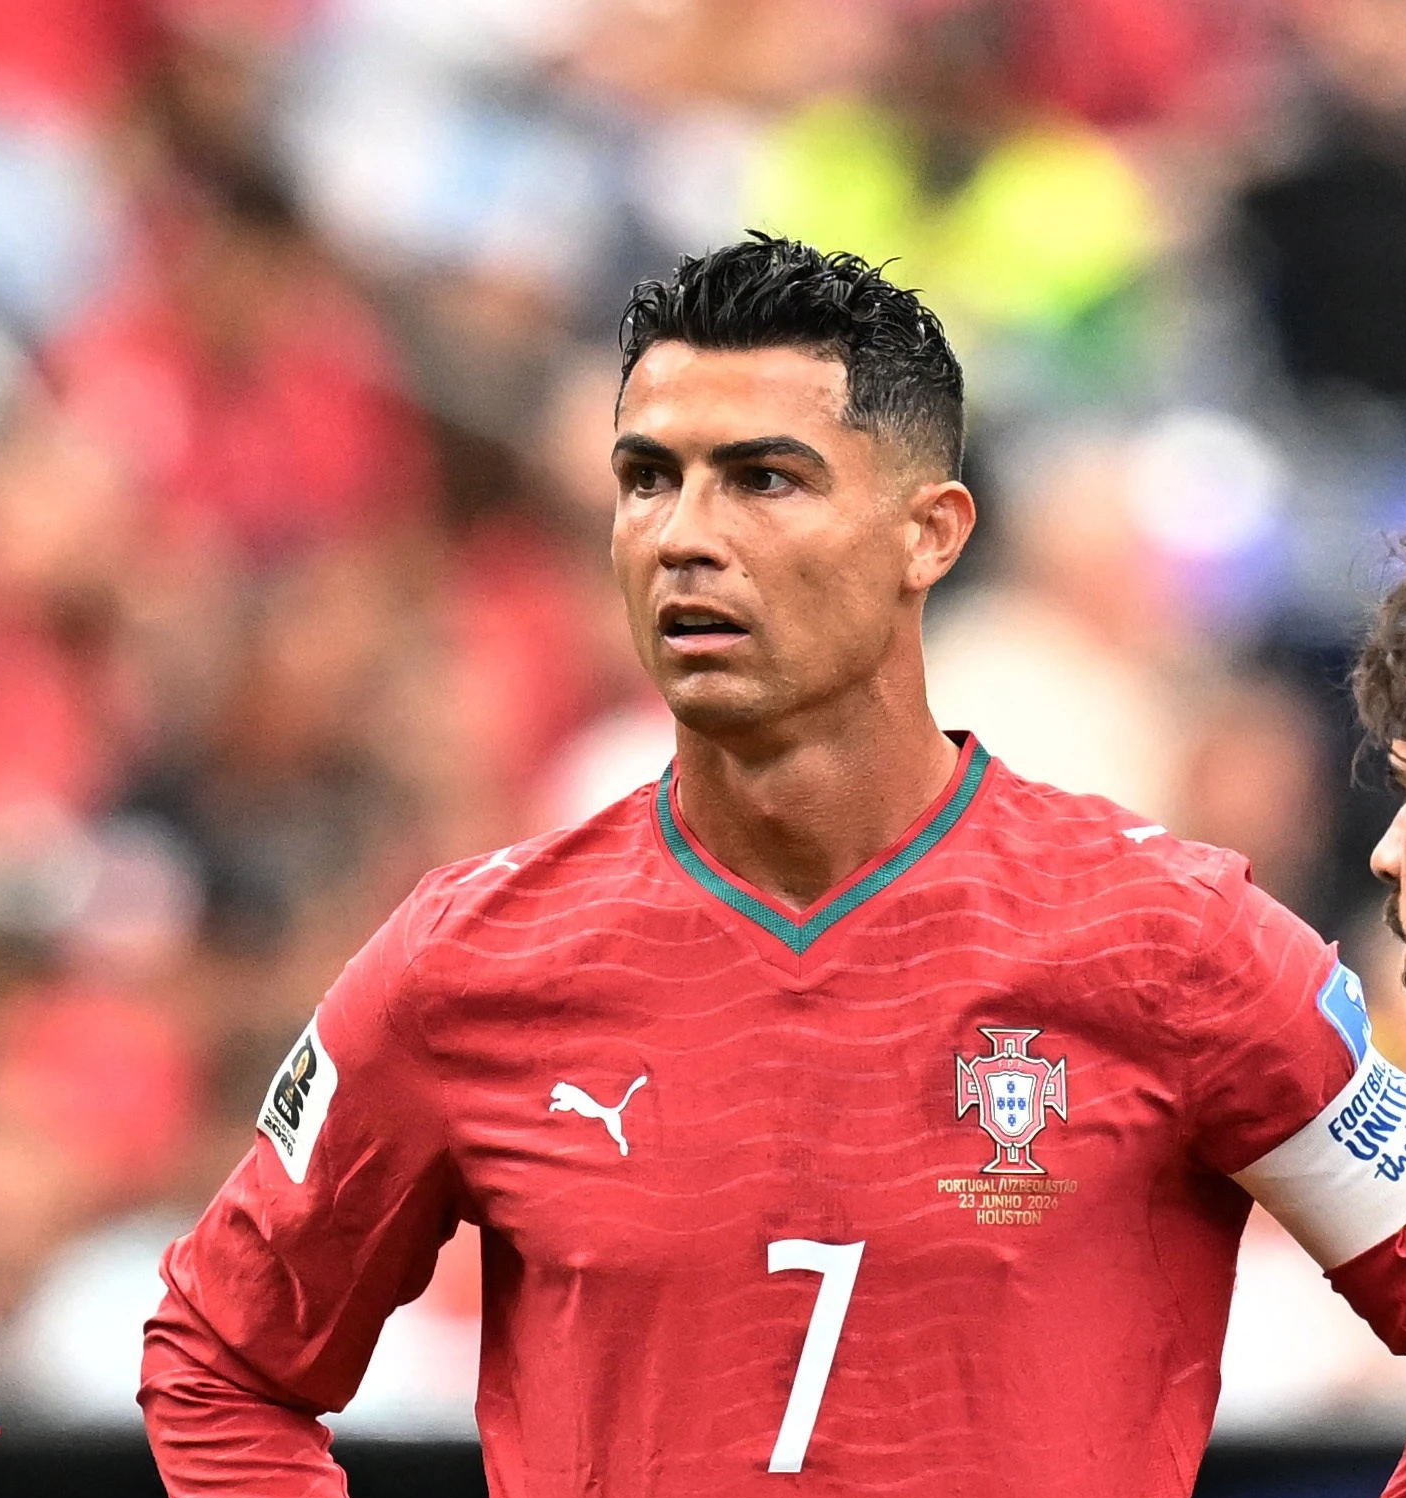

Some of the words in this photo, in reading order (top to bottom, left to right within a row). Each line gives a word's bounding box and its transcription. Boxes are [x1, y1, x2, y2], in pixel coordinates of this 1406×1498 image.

[1327, 1059, 1386, 1143] FOOTBAL
[263, 1114, 294, 1158] 2026
[958, 1193, 975, 1209] 23
[979, 1195, 1022, 1209] JUNHO
[1027, 1195, 1059, 1210] 2026
[976, 1209, 1042, 1226] HOUSTON
[768, 1239, 866, 1473] 7
